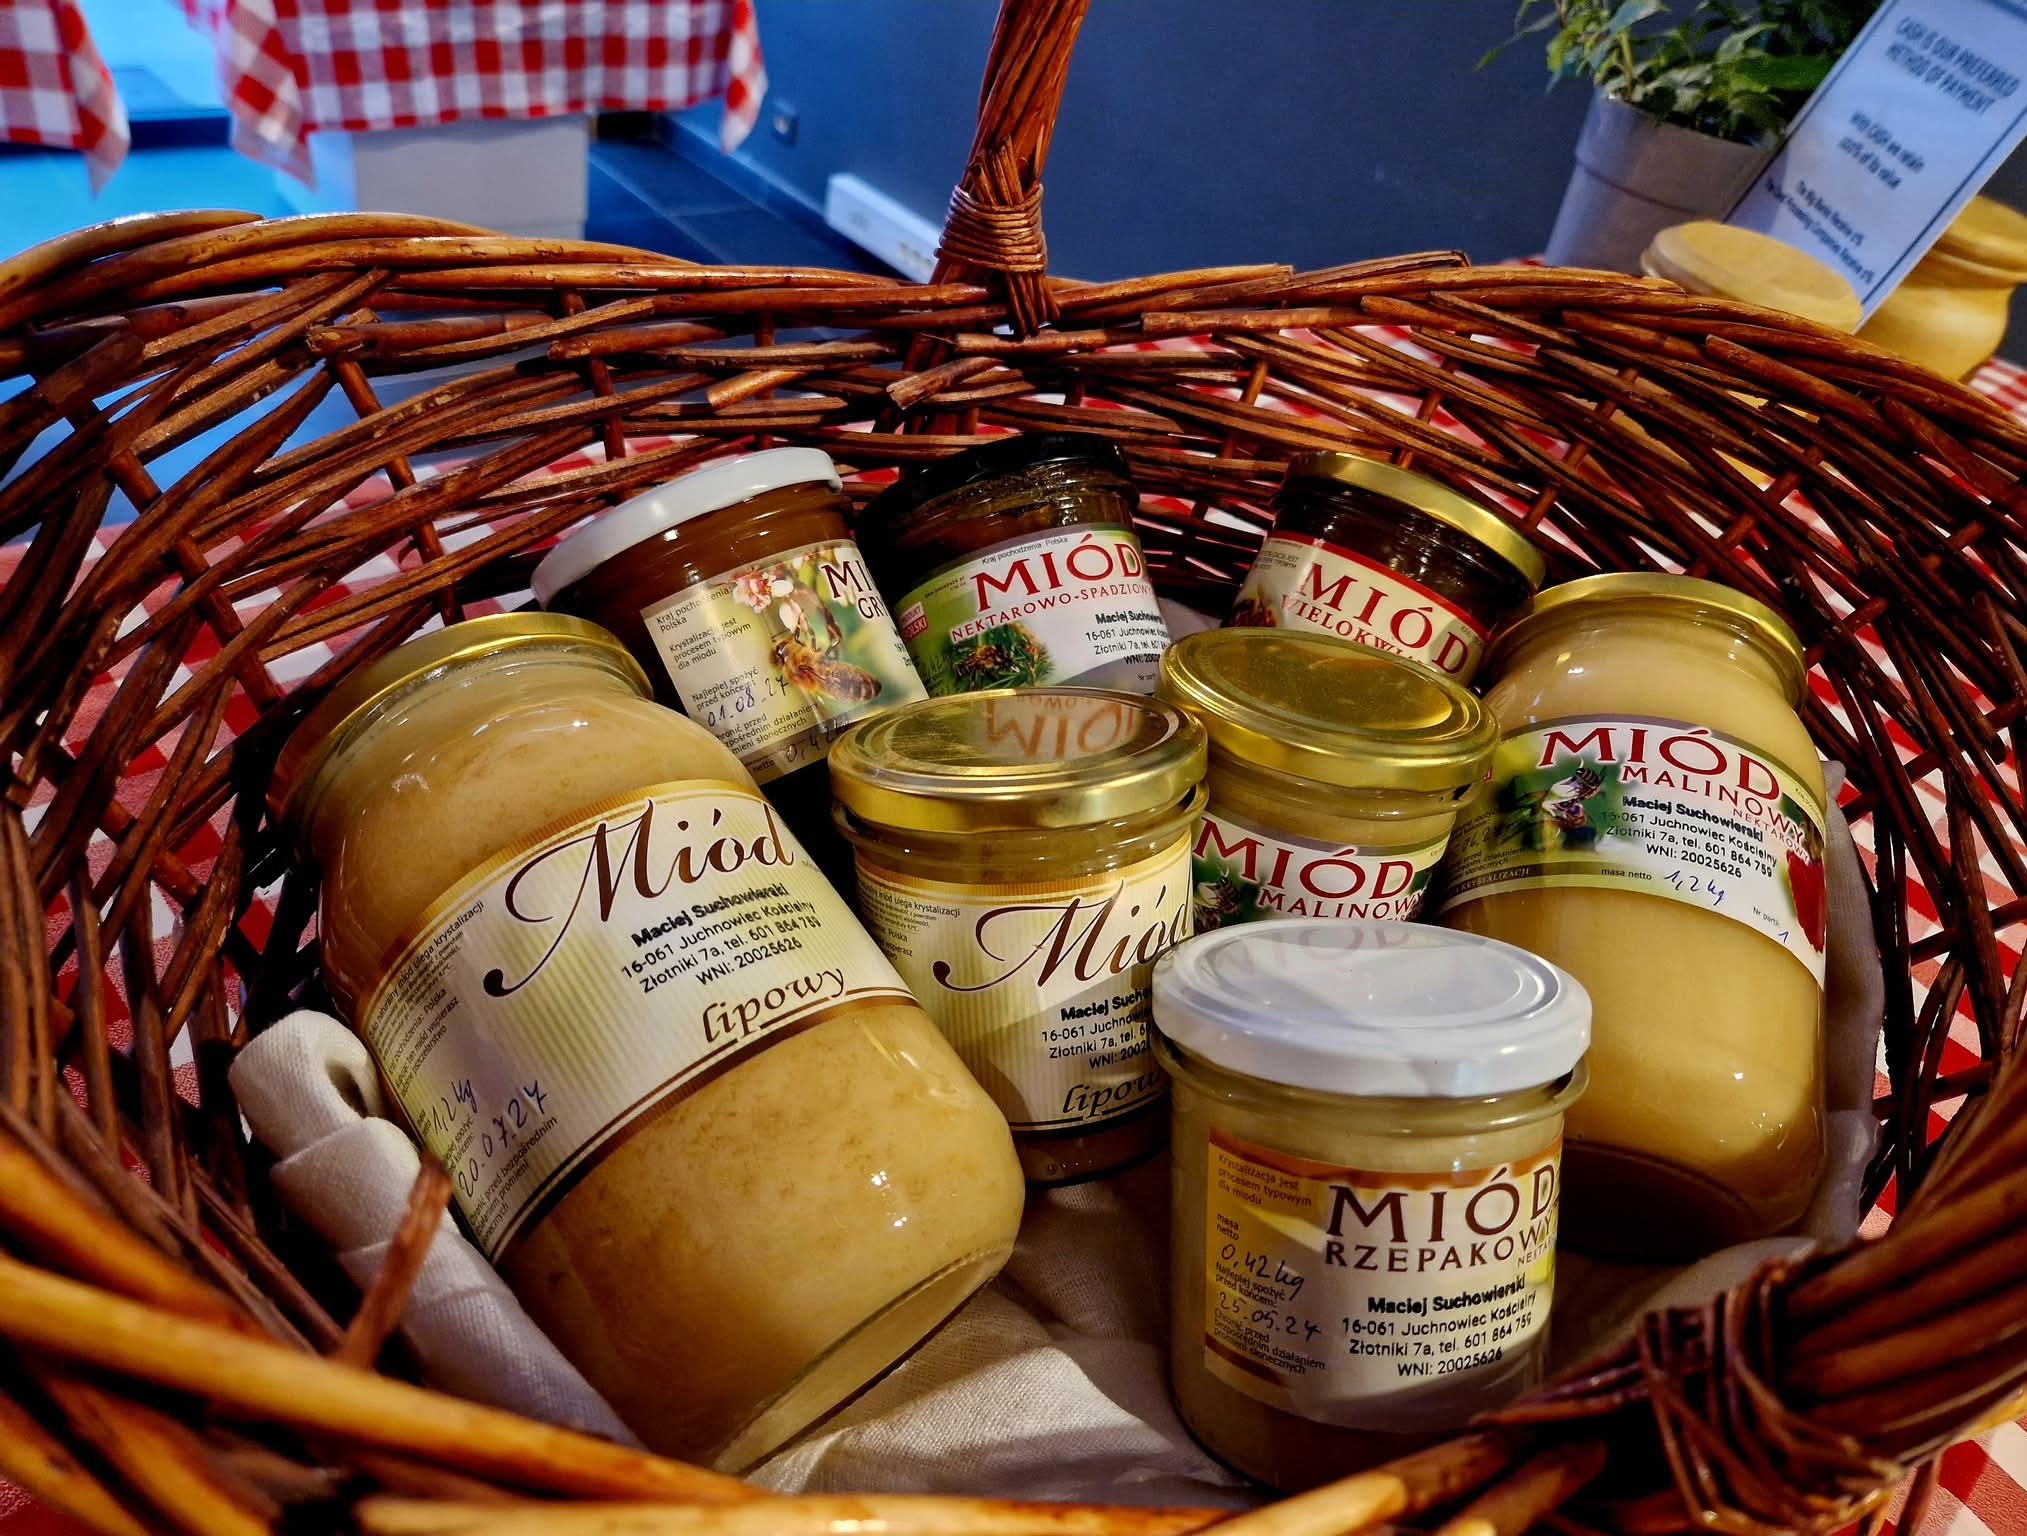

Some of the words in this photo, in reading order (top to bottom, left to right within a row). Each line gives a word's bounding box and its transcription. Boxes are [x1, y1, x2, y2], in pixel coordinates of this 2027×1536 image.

[1955, 49, 2019, 97] PREFERRED
[1938, 73, 1995, 115] PAYMENT
[970, 533, 1143, 613] MIÓD
[656, 611, 675, 625] Kraj
[660, 616, 688, 634] Polska
[721, 616, 737, 630] jest
[1095, 611, 1129, 625] Maciej
[1297, 562, 1469, 674] MIÓD
[1085, 629, 1116, 641] 16-061
[1094, 642, 1127, 655] Złotniki
[673, 640, 712, 663] procesem
[678, 660, 690, 671] dla
[691, 648, 717, 664] miodu
[692, 679, 728, 702] Najlepiej
[696, 696, 720, 712] przed
[743, 713, 767, 729] przed
[756, 717, 808, 745] słonecznych
[1539, 728, 1780, 801] MIÓD
[1622, 765, 1804, 845] MALINOWY
[1623, 795, 1672, 815] Maciej
[1676, 803, 1764, 842] Suchowierski
[1649, 816, 1725, 843] Juchnowiec
[1728, 835, 1778, 868] Kościelny
[1660, 831, 1678, 846] 7a,
[1682, 836, 1700, 850] tel.
[1705, 841, 1726, 858] 601
[1730, 851, 1751, 868] 864
[1755, 860, 1773, 878] 759
[1193, 816, 1414, 899] MIÓD
[1646, 844, 1677, 860] WNI:
[1681, 851, 1742, 879] 20025626
[1601, 868, 1625, 878] masa
[1628, 870, 1652, 881] netto
[483, 798, 794, 998] Miód
[914, 901, 960, 918] krystalizacji
[630, 910, 694, 949] Maciej
[691, 882, 790, 919] Suchowierski
[413, 945, 434, 970] ulega
[433, 899, 485, 948] krystalizacji
[621, 943, 675, 979] 16-061
[679, 909, 763, 950] Juchnowiec
[888, 927, 908, 942] Polska
[639, 954, 700, 994] Złotniki
[703, 947, 725, 962] 7a,
[723, 935, 749, 952] tel.
[748, 924, 773, 942] 601
[777, 918, 801, 934] 864
[695, 961, 736, 987] WNI:
[734, 936, 803, 970] 20025626
[423, 988, 447, 1014] Polska
[428, 996, 459, 1033] wspierasz
[702, 967, 845, 1044] lipowy
[1060, 999, 1109, 1021] Maciej
[1042, 1025, 1085, 1042] 16-061
[1049, 1041, 1097, 1059] Złotniki
[1119, 1029, 1137, 1043] tel.
[1088, 1053, 1118, 1069] WNI:
[501, 1116, 558, 1176] bezpośrednim
[499, 1159, 530, 1199] promieni
[1232, 1188, 1262, 1206] miodu
[1264, 1185, 1312, 1207] typowym
[1327, 1164, 1555, 1243] MIÓD
[1216, 1213, 1239, 1231] masa
[1216, 1223, 1239, 1241] netto
[1325, 1210, 1553, 1272] RZEPAKOWY
[1215, 1261, 1251, 1289] Najlepiej
[1221, 1243, 1271, 1278] 0,42
[1215, 1273, 1237, 1290] przed
[1367, 1297, 1428, 1317] Maciej
[1433, 1272, 1526, 1312] Suchowierski
[1342, 1317, 1395, 1336] 16-061
[1401, 1313, 1487, 1336] Juchnowiec
[1490, 1290, 1537, 1323] Kościelny
[1349, 1339, 1408, 1356] Złotniki
[1413, 1342, 1434, 1357] 7a,
[1439, 1338, 1459, 1354] tel.
[1465, 1331, 1487, 1349] 601
[1492, 1326, 1512, 1342] 864
[1515, 1311, 1532, 1333] 759
[1272, 1347, 1326, 1370] działaniem
[1397, 1362, 1433, 1377] WNI:
[1438, 1347, 1503, 1375] 20025626
